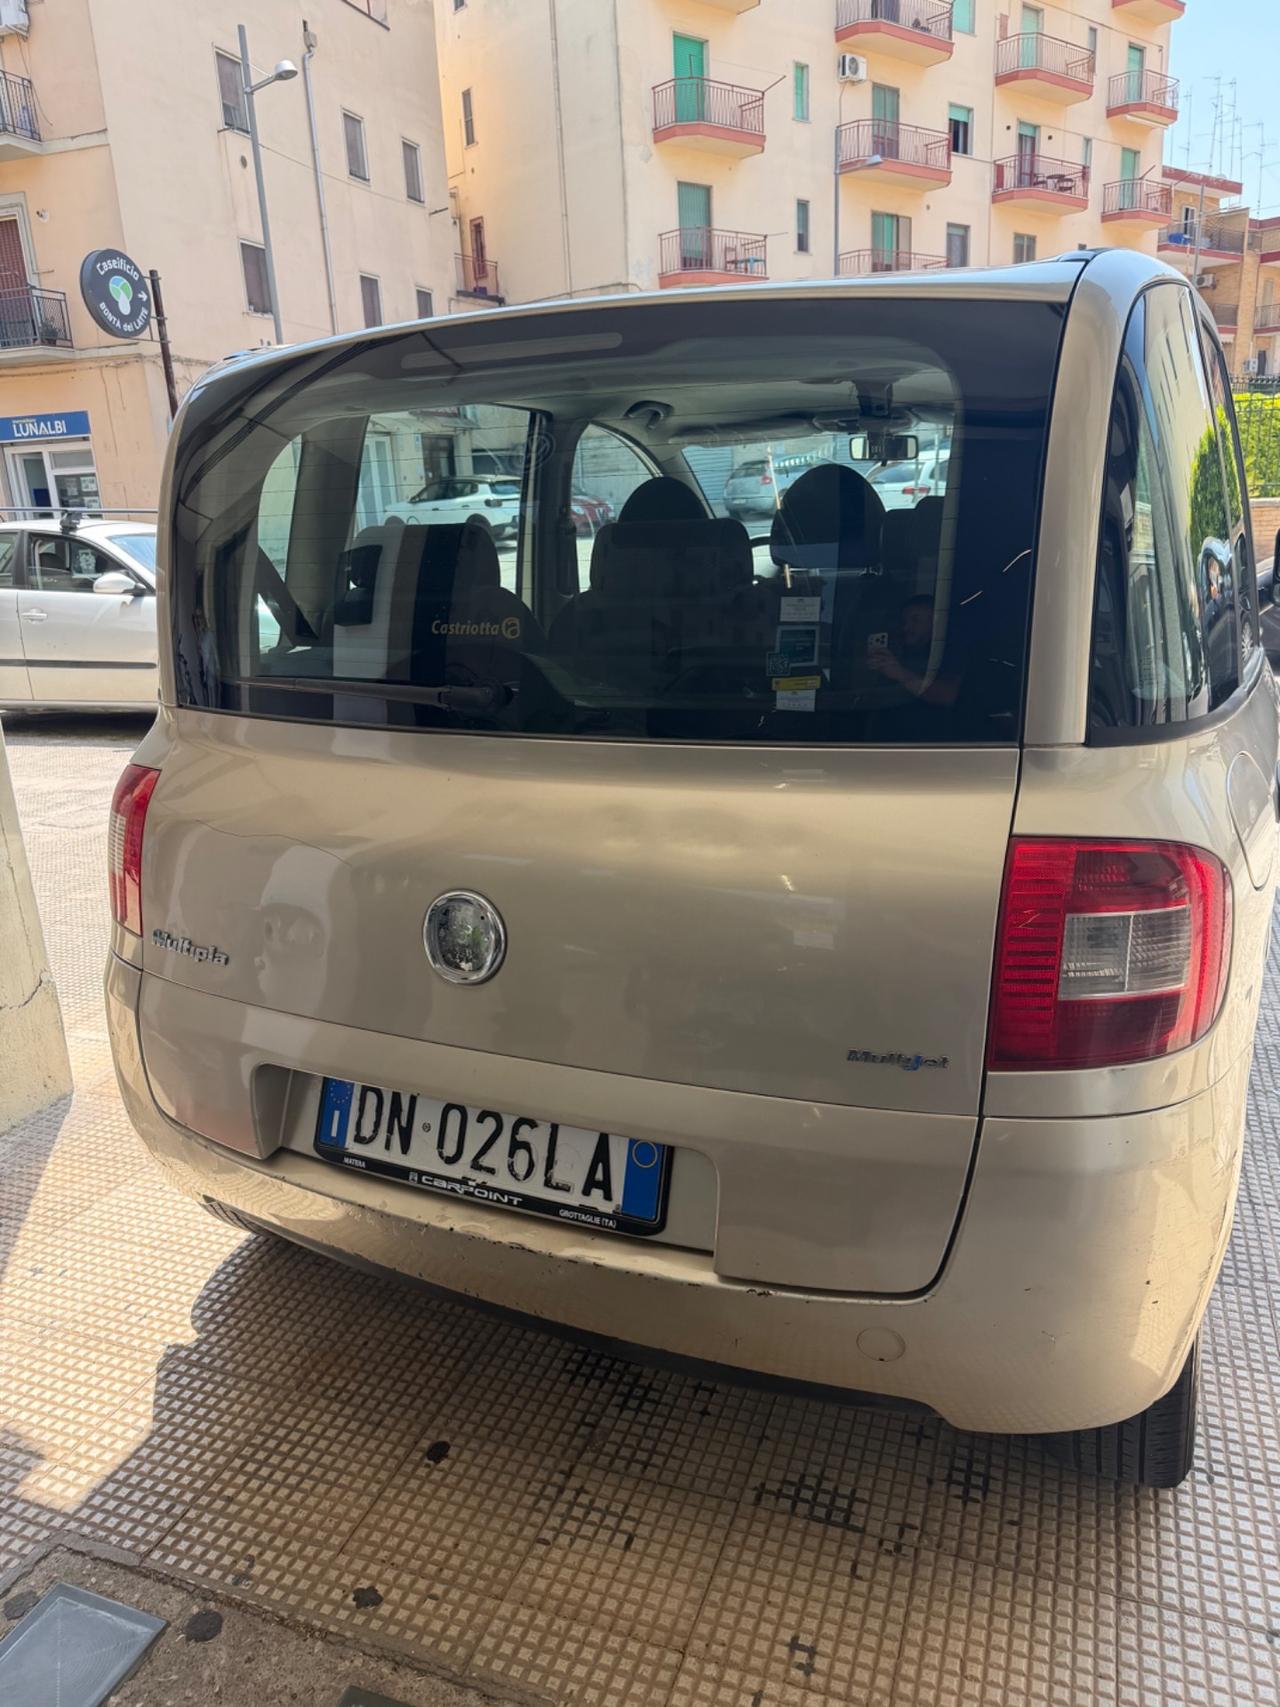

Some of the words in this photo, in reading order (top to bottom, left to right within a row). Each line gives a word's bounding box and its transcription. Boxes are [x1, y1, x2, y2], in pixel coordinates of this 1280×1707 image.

[96, 257, 140, 281] Caseificio
[13, 420, 67, 437] LUNALBI
[431, 620, 500, 636] Castriotta
[152, 928, 230, 966] Multipla
[558, 1209, 601, 1225] GROTTAGLIE
